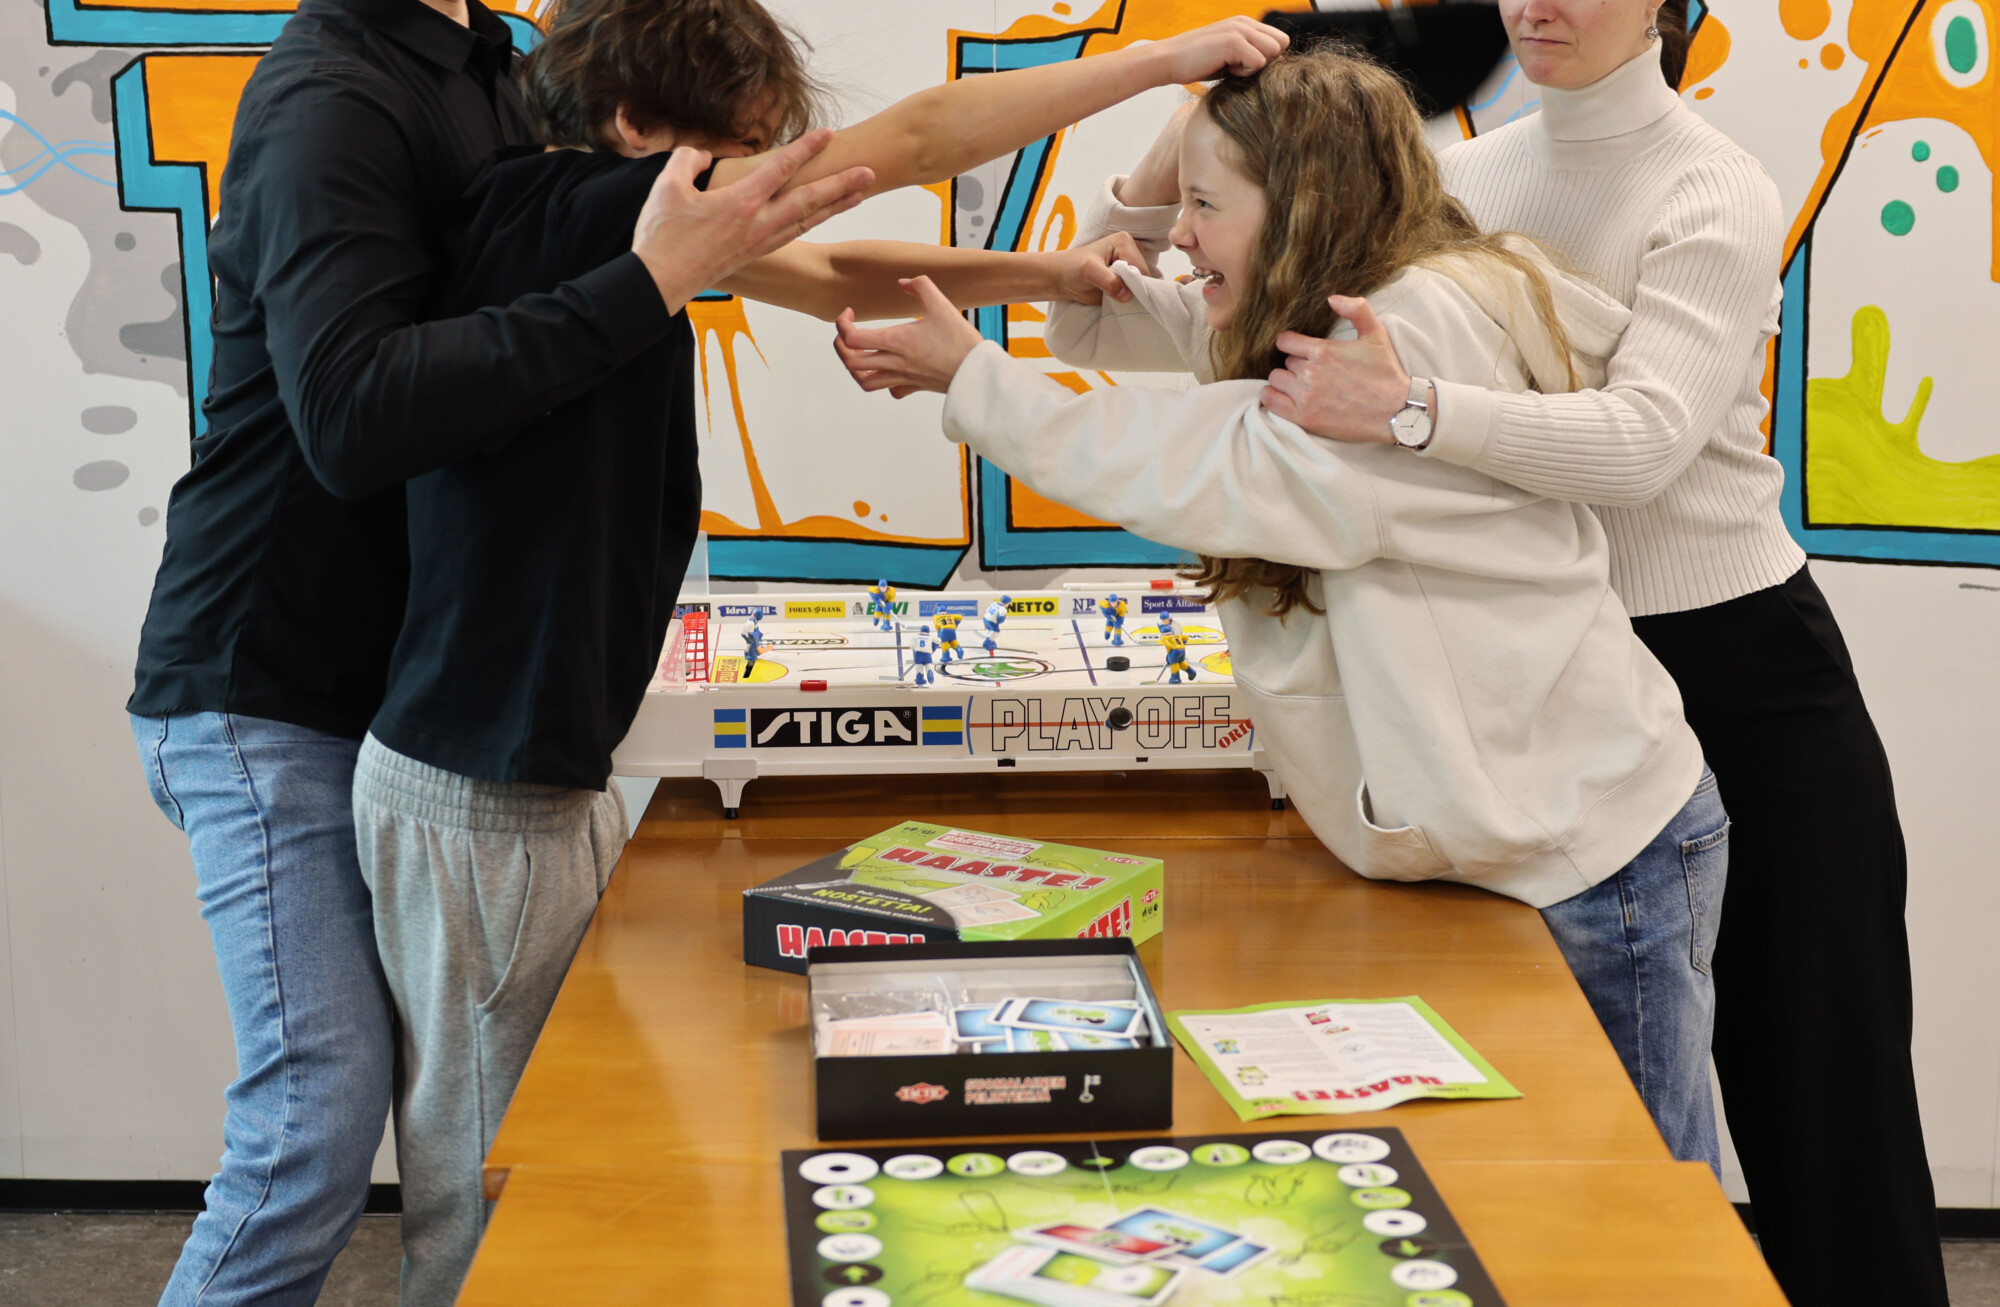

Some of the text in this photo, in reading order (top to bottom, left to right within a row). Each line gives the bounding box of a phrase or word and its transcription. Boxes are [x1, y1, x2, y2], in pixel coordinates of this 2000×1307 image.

[725, 606, 746, 614] Idre
[821, 605, 842, 613] BANK
[1007, 600, 1055, 613] NETTO
[1072, 597, 1096, 611] NP
[1143, 599, 1165, 610] Sport
[1166, 599, 1174, 608] &
[757, 710, 912, 745] STIGA
[991, 695, 1230, 751] PLAY OFF
[876, 846, 1111, 890] HAASTE!
[812, 889, 932, 913] NOSTETTA!
[964, 1076, 1067, 1090] SUOMALAINEN
[1292, 1075, 1444, 1101] HAASTE!
